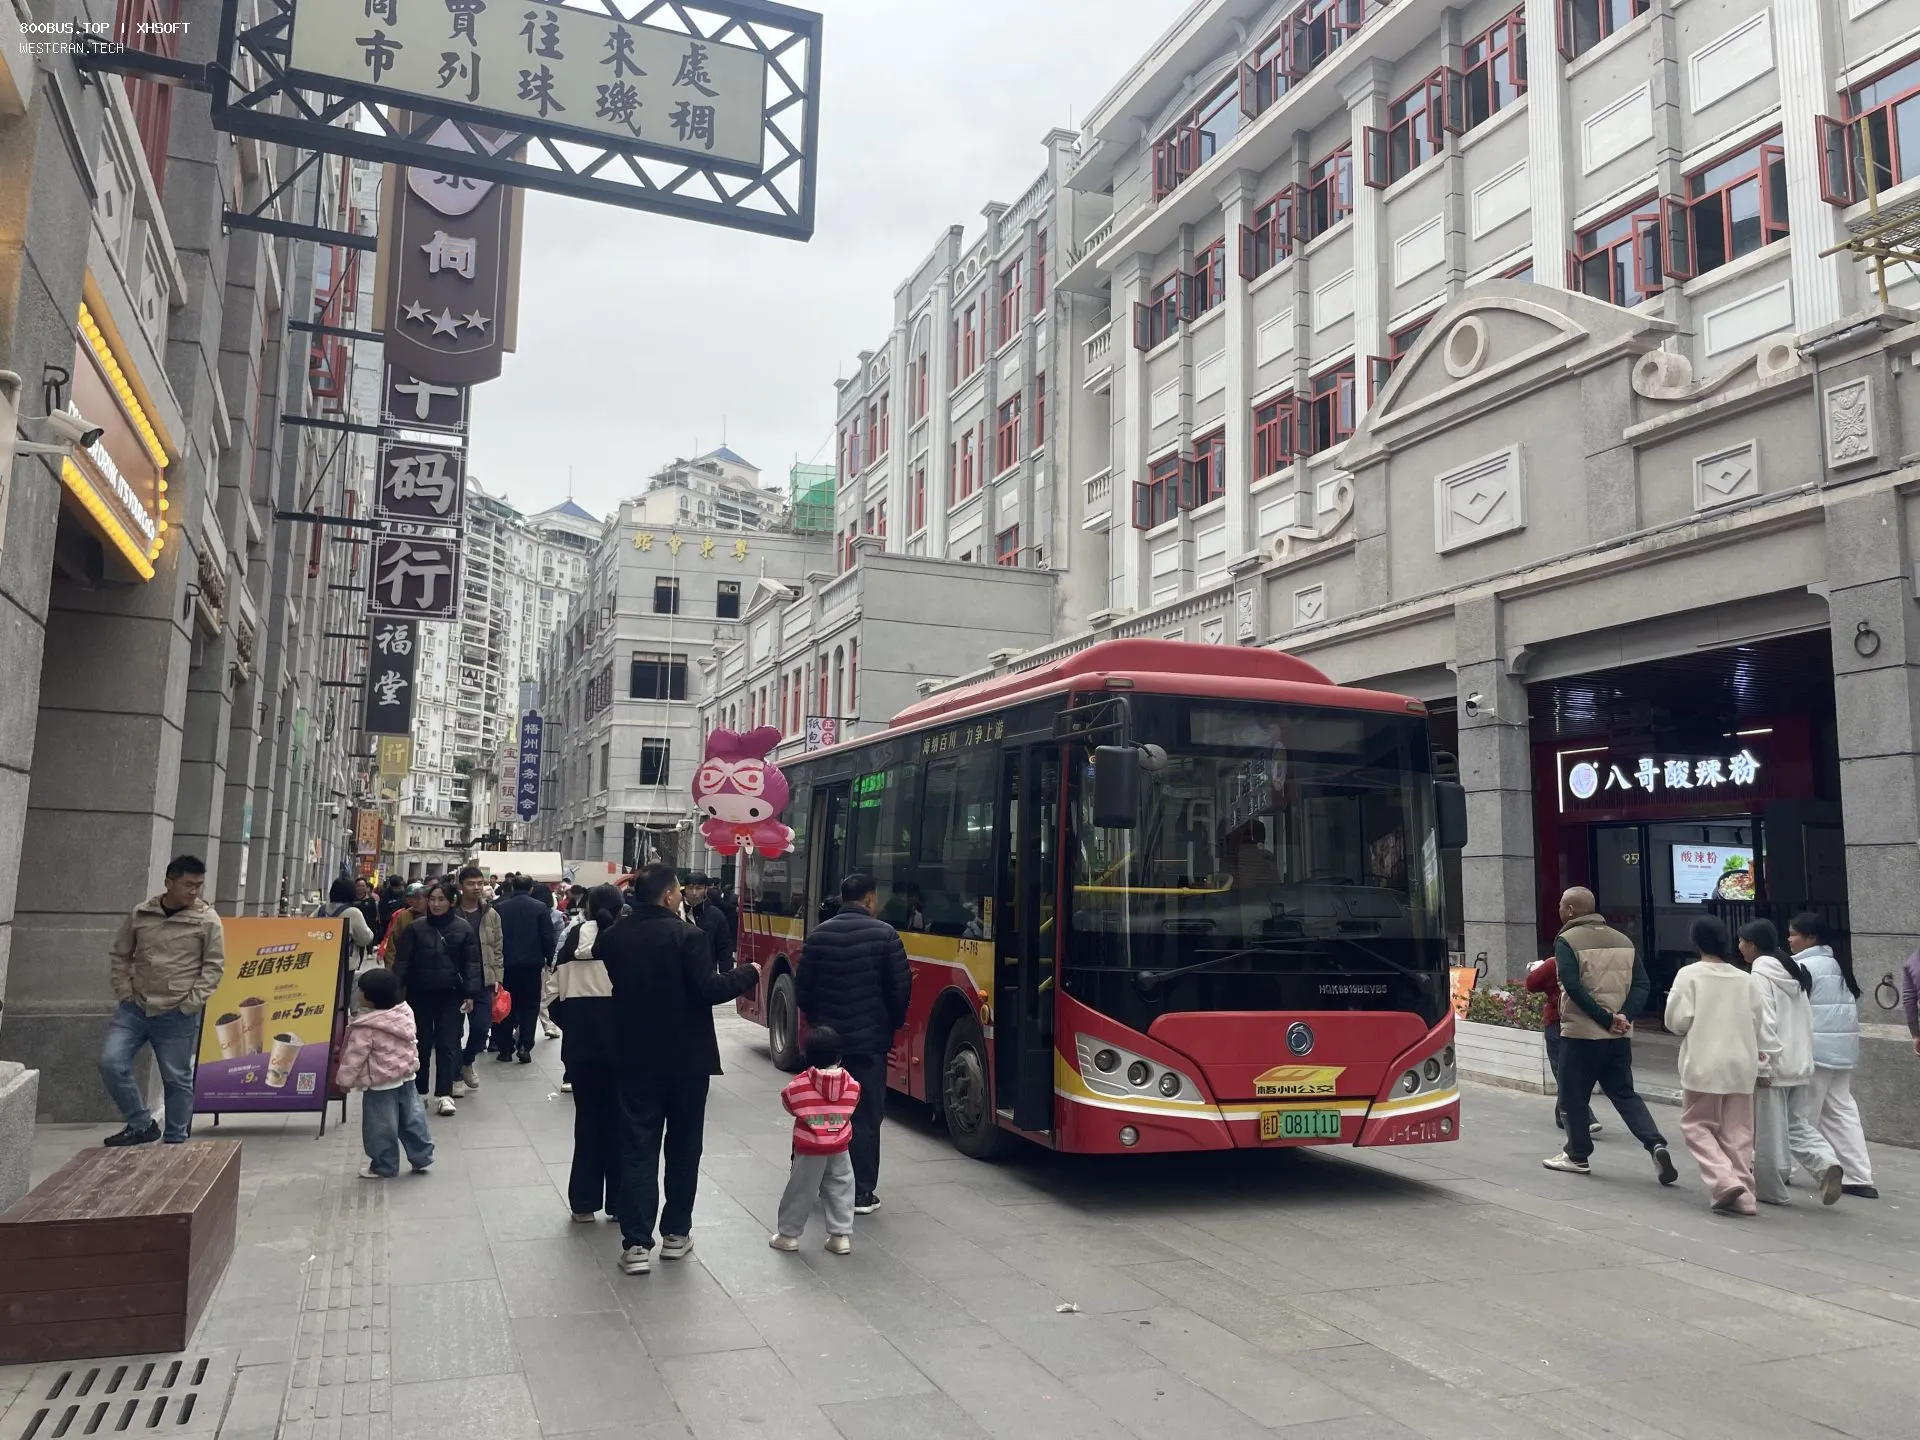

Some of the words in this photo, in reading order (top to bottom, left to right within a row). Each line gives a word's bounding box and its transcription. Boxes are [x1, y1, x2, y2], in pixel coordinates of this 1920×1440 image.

[1604, 749, 1761, 792] 八哥酸辣粉
[237, 951, 315, 979] 超值特惠
[1257, 1084, 1335, 1095] 梧州公交
